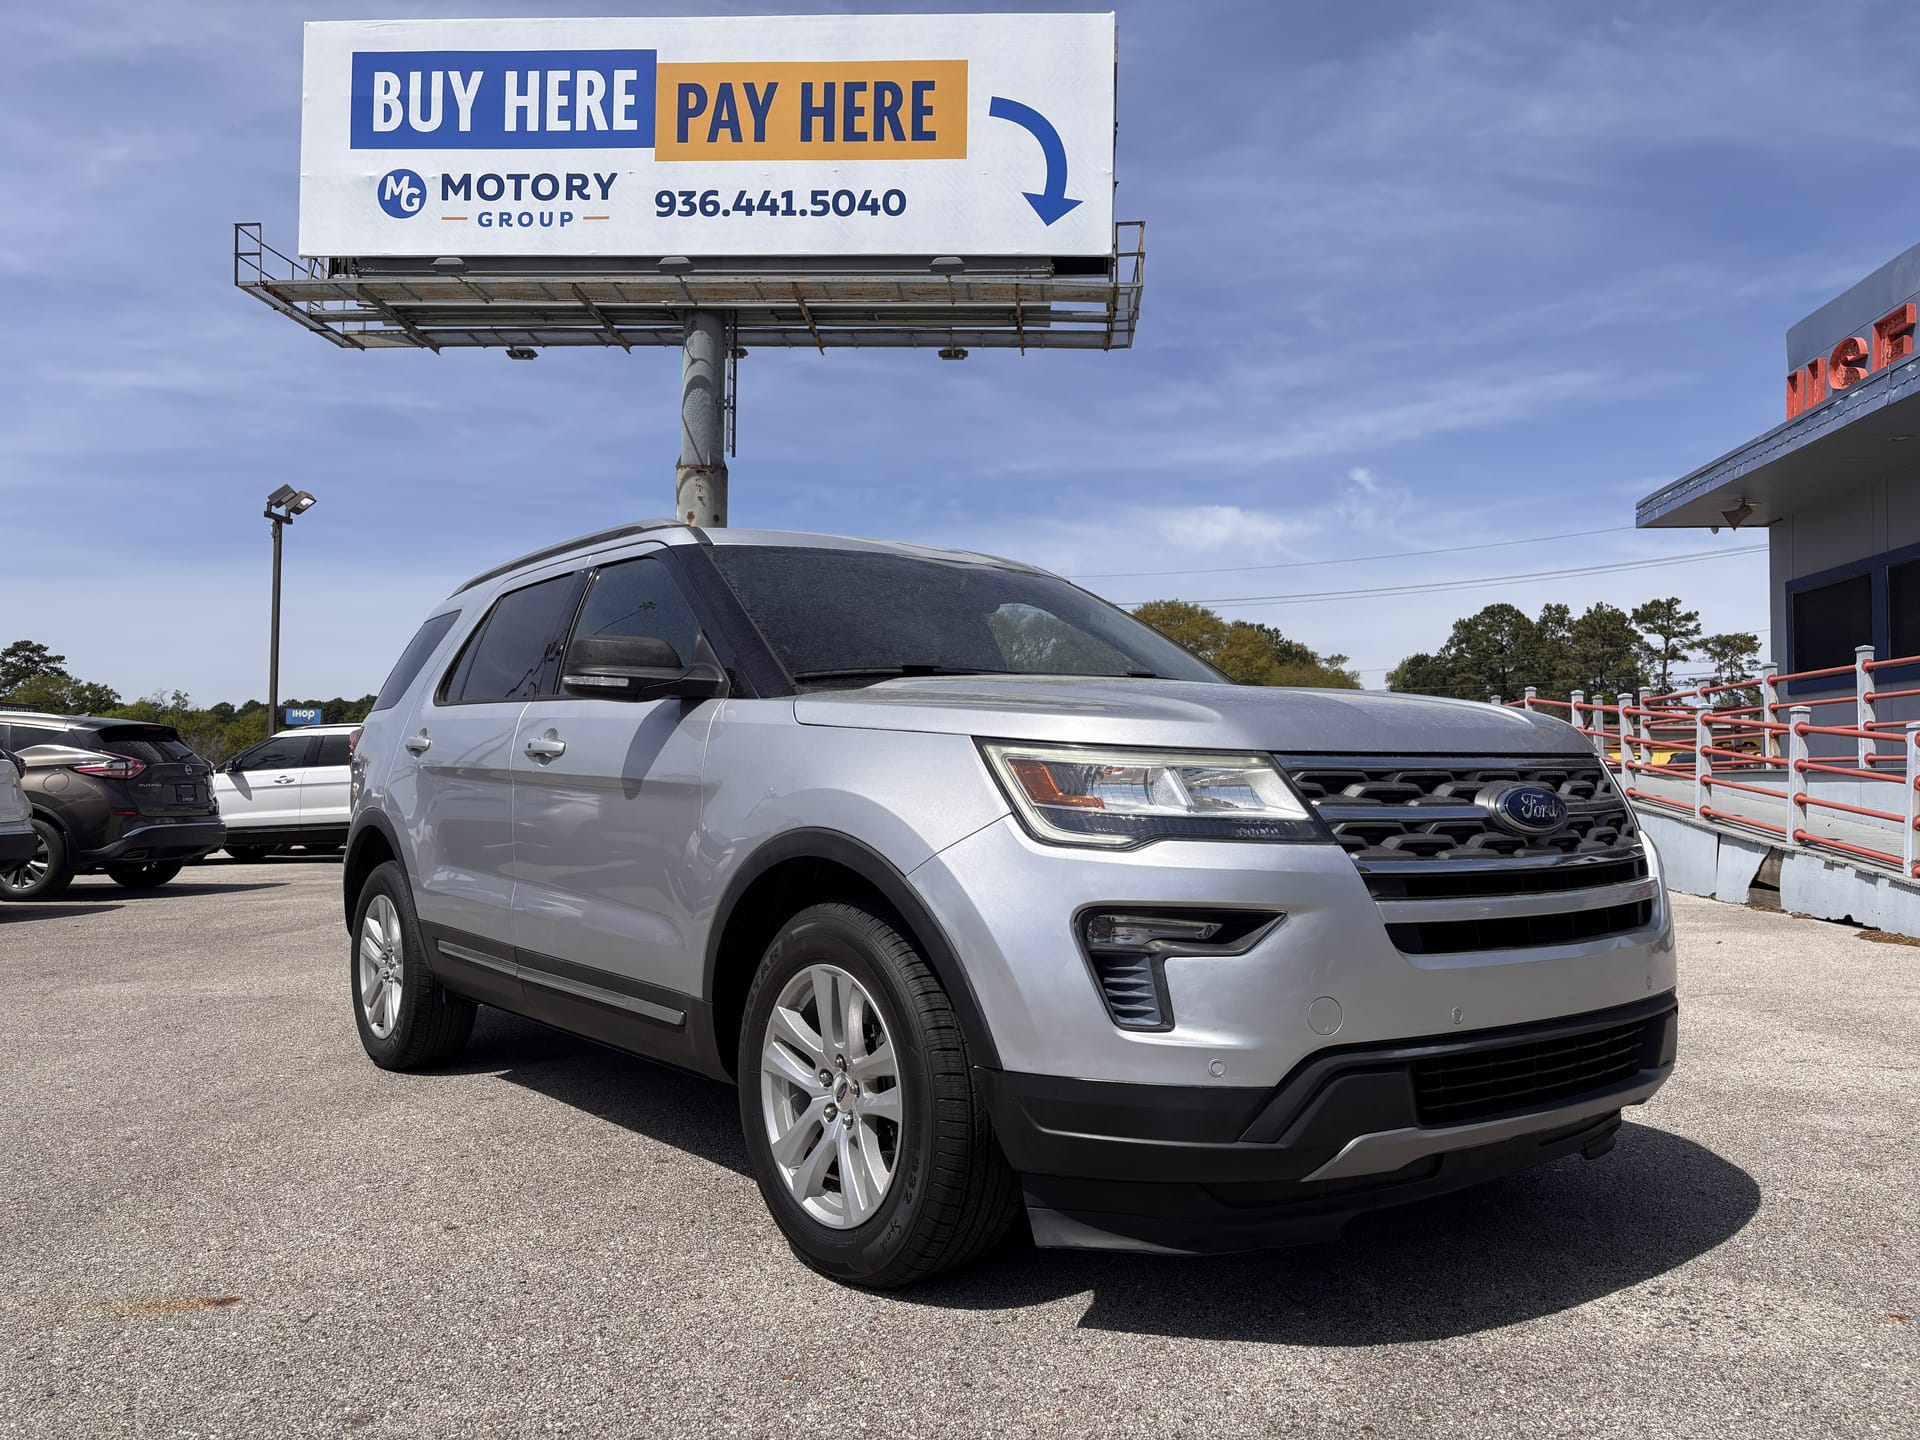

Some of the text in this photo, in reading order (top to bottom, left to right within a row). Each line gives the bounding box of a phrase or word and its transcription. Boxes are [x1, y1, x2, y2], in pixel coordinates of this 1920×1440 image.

[372, 69, 638, 133] BUY HERE
[676, 80, 937, 144] PAY HERE
[384, 174, 422, 213] MG
[441, 172, 618, 201] MOTORY
[654, 188, 907, 218] 936.441.5040
[477, 211, 574, 228] GROUP
[1520, 793, 1559, 818] Ford
